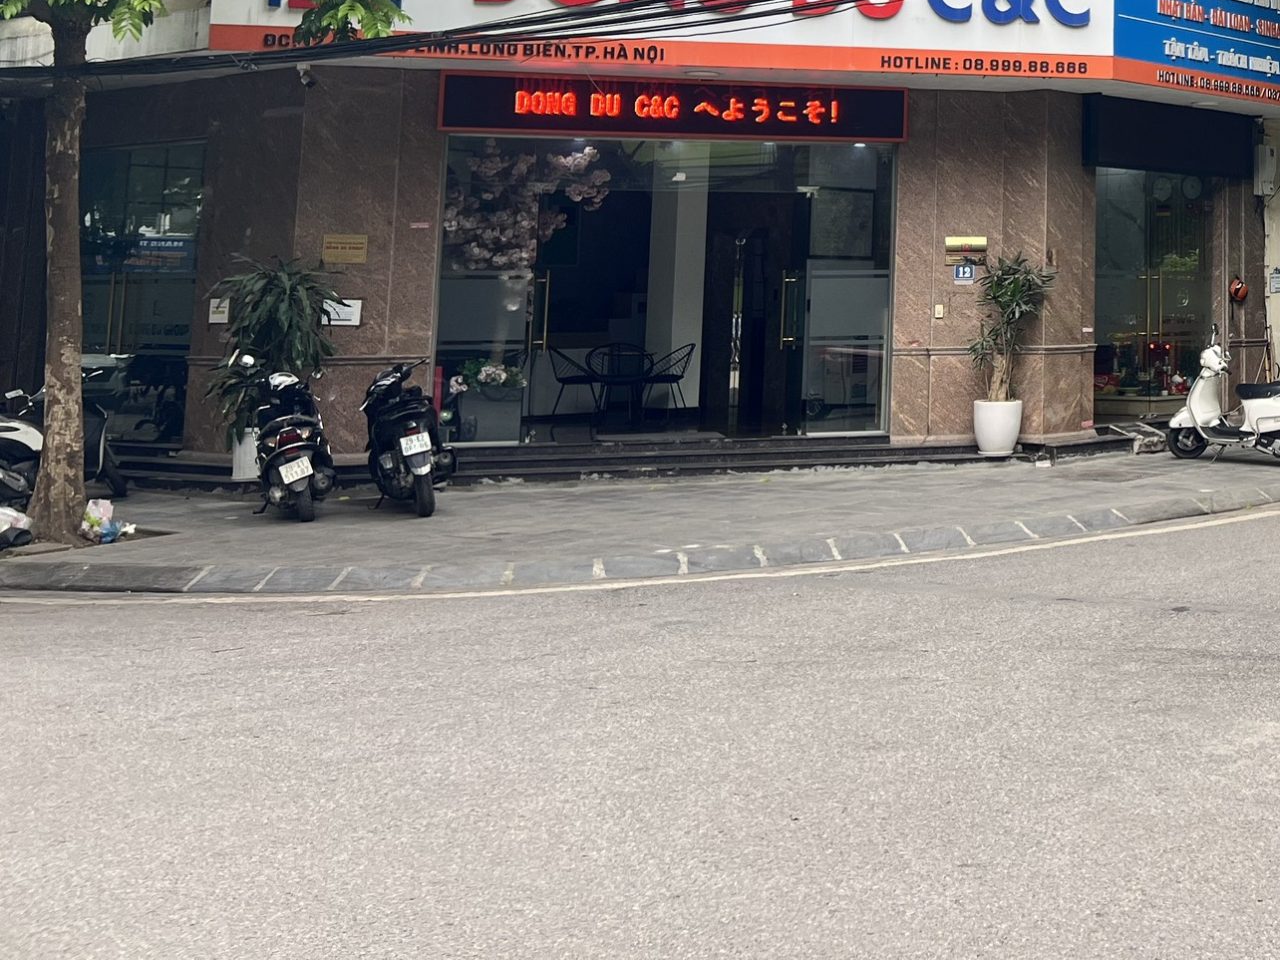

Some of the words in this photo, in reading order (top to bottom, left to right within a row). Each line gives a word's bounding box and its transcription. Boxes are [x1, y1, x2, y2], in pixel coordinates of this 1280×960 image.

[603, 44, 628, 61] HÀ
[633, 45, 665, 64] NỘI
[514, 90, 577, 116] DONG
[590, 93, 621, 117] DU
[634, 95, 680, 119] C&C
[958, 266, 971, 278] 12
